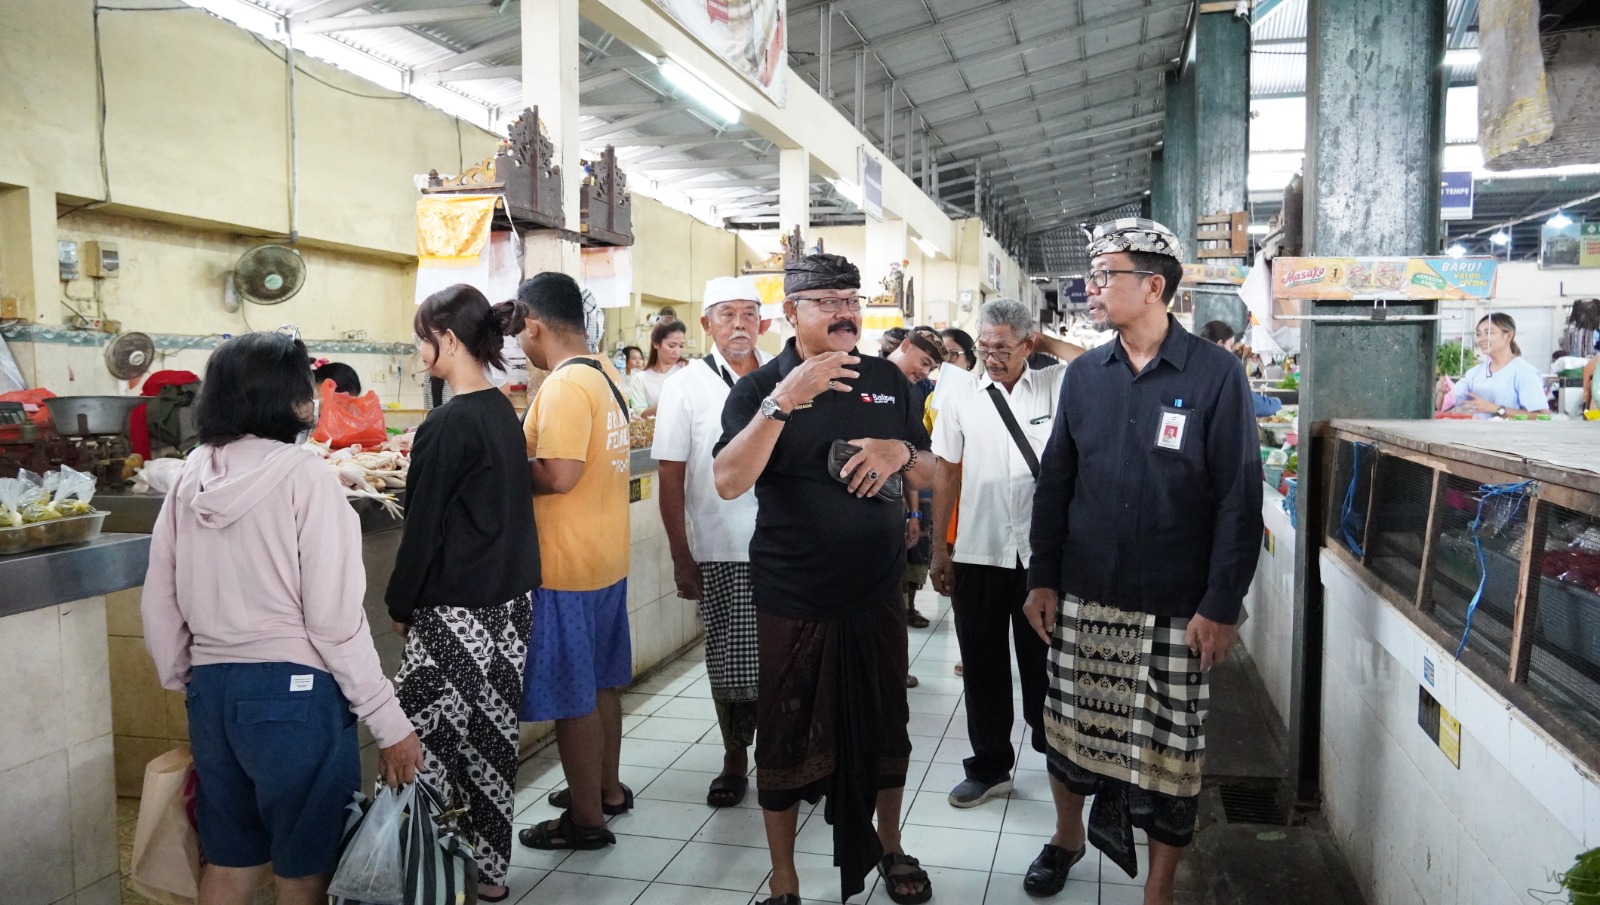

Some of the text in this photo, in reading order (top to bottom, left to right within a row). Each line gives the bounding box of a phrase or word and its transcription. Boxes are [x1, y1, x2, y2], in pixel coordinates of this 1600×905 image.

[1445, 187, 1469, 195] TEMPE
[1442, 262, 1482, 272] BARU!
[1281, 267, 1325, 284] Masako
[1333, 268, 1338, 278] 1
